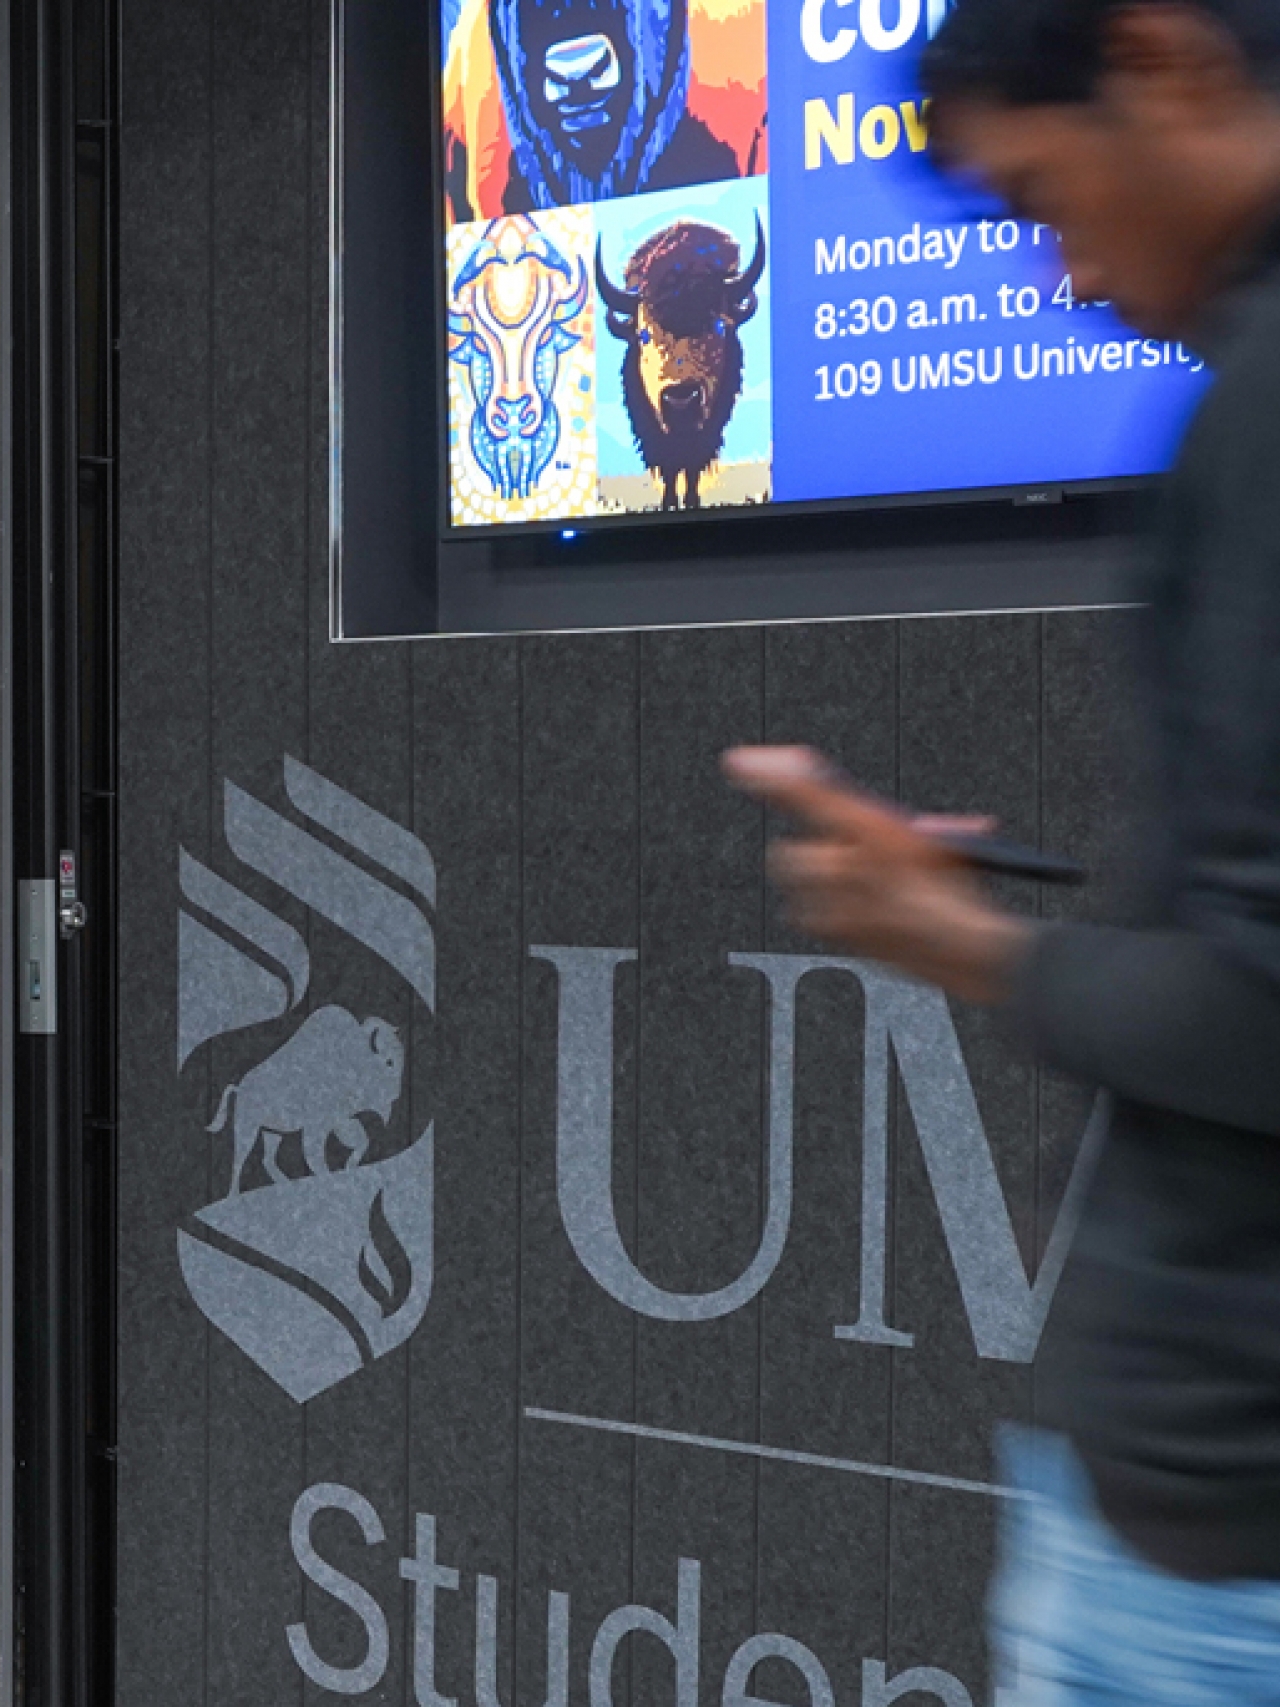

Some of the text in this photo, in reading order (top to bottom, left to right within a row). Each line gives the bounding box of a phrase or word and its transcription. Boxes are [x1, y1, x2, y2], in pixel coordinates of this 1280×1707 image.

[815, 222, 968, 275] Monday
[977, 219, 1020, 253] to
[815, 296, 897, 339] 8:30
[906, 293, 988, 330] a.m.
[997, 284, 1040, 319] to
[815, 336, 1205, 401] 109 UMSU Universit
[528, 944, 1113, 1364] UM
